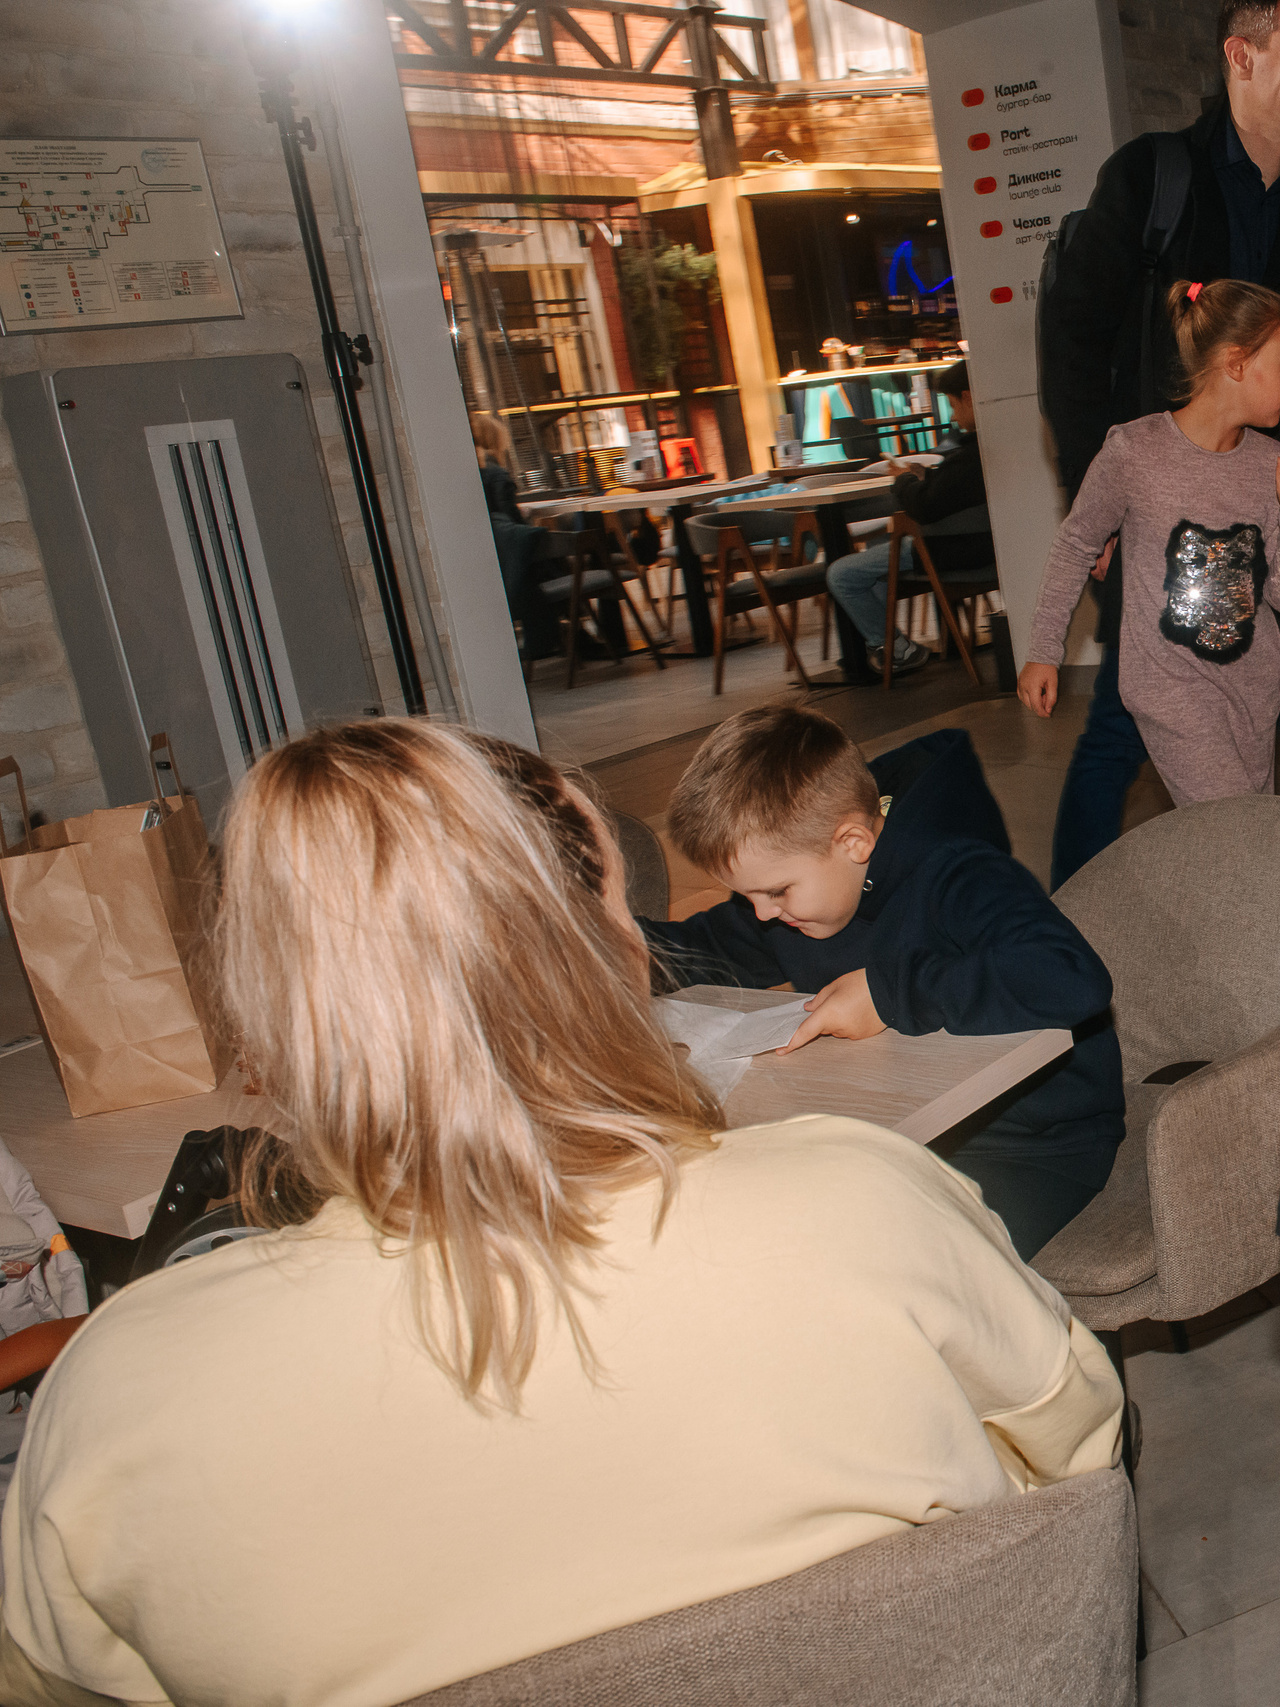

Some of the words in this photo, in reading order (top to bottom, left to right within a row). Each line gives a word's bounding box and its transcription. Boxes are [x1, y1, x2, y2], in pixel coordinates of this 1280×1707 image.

[994, 79, 1038, 98] Карма
[1001, 127, 1030, 143] Port
[1008, 168, 1062, 188] Диккенс
[1009, 187, 1040, 201] lounge
[1042, 184, 1062, 195] club
[1013, 215, 1051, 231] Чехов
